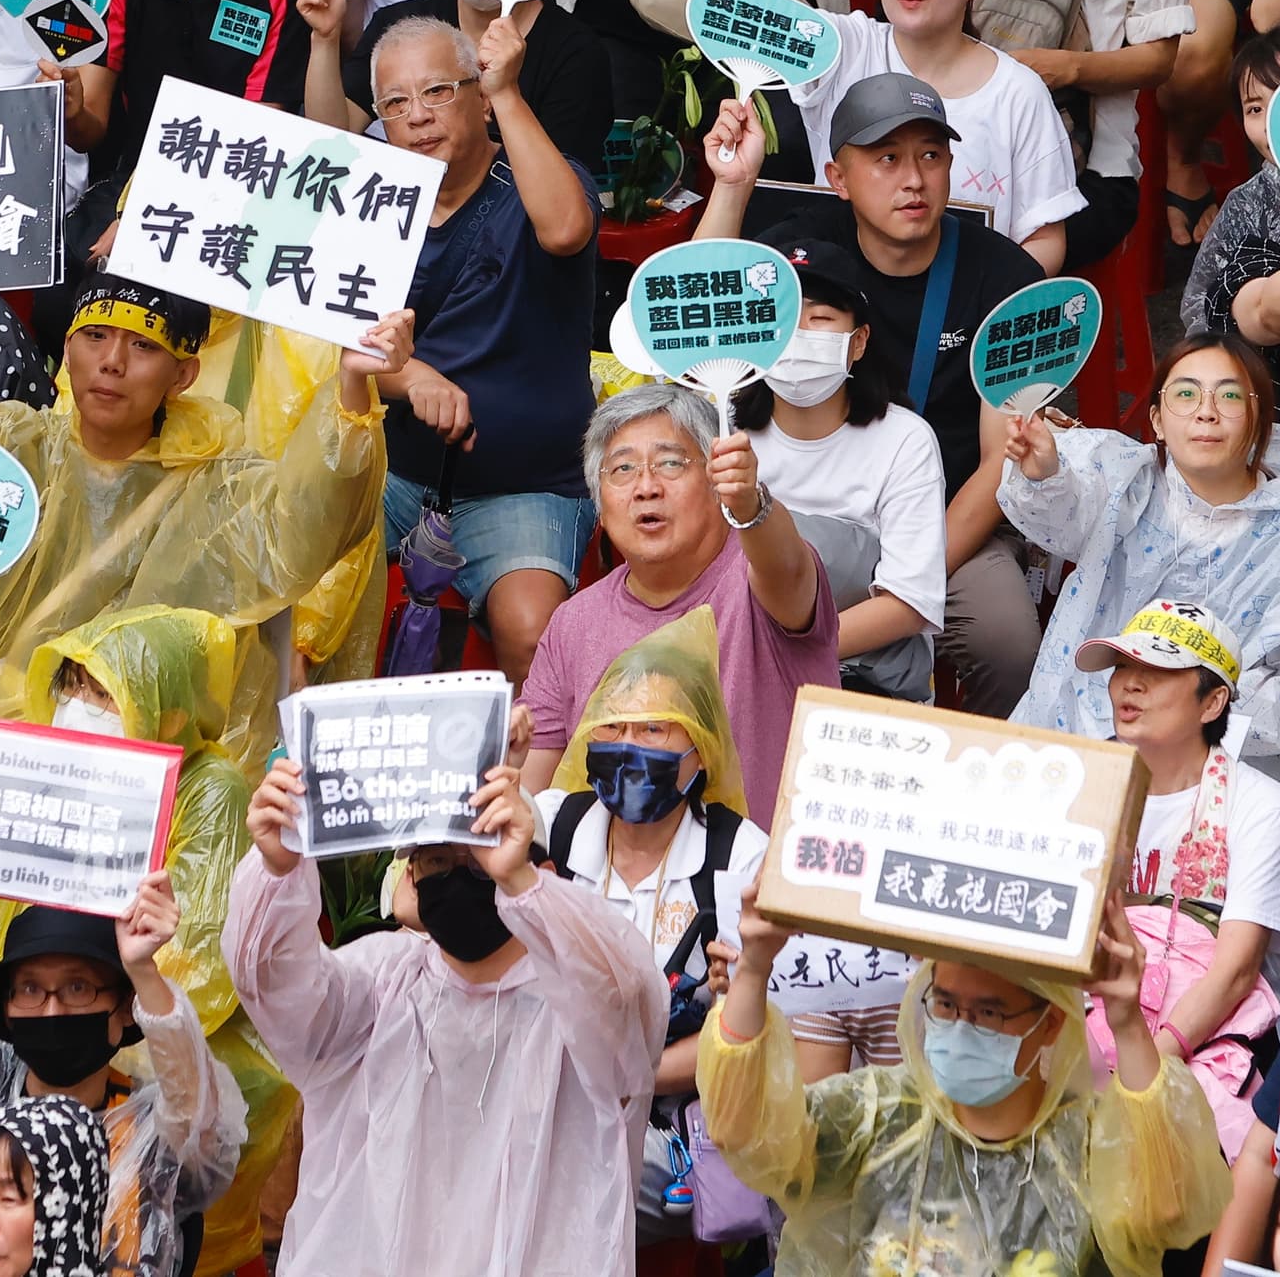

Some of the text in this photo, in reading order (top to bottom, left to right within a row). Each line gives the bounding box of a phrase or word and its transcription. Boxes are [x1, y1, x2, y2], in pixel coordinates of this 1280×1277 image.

[702, 10, 817, 59] 藍白黑箱
[157, 114, 421, 241] 謝謝你們
[140, 202, 379, 321] 守護民主
[646, 268, 742, 301] 我藐視
[649, 298, 779, 333] 藍白黑箱
[988, 302, 1060, 343] 我藐視
[986, 325, 1081, 371] 藍白黑箱
[818, 720, 933, 756] 拒絕暴力
[319, 776, 360, 805] Bô
[810, 761, 926, 797] 逐條審查
[796, 835, 866, 877] 我怕
[882, 859, 1069, 932] 我藐視國會
